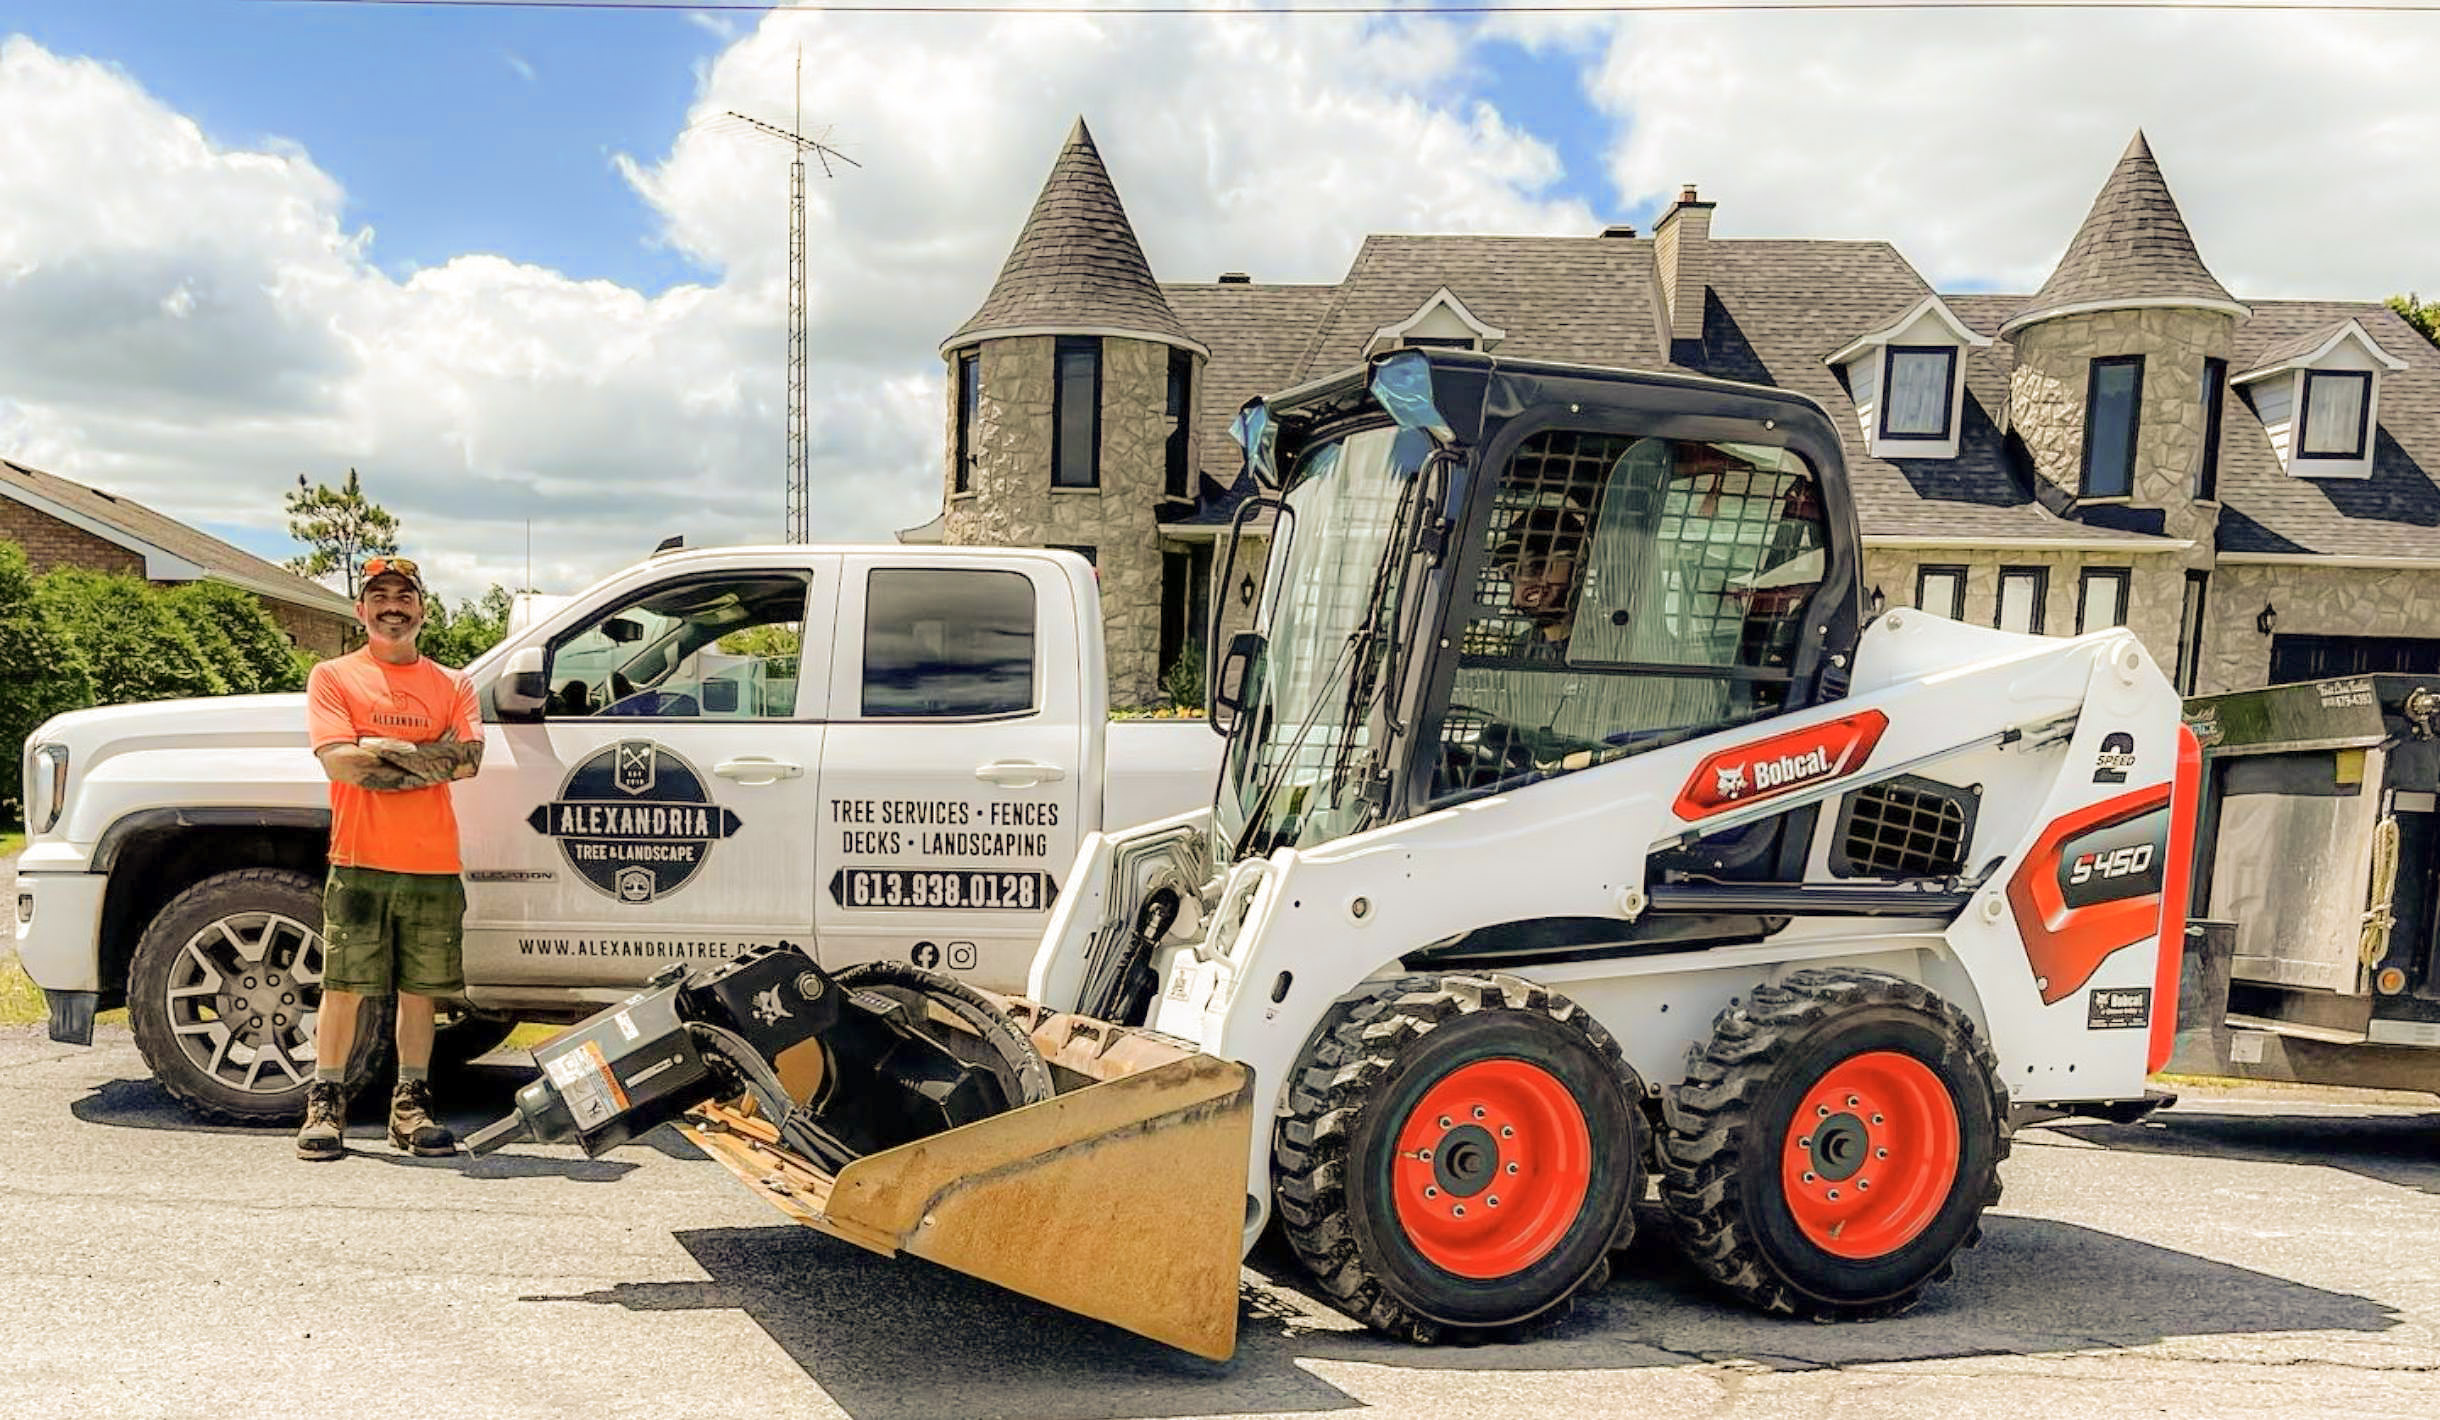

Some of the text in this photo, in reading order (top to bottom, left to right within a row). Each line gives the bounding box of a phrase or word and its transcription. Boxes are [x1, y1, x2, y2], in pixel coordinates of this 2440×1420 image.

[373, 713, 429, 729] ALEXANDRIA
[1752, 744, 1828, 790] Bobcat
[2096, 754, 2136, 767] SPEED
[560, 805, 709, 836] ALEXANDRIA
[831, 799, 1059, 826] TREE SERVICES FENCES
[575, 843, 607, 861] TREE
[617, 844, 695, 862] LANDSCAPE
[843, 830, 1047, 857] DECKS LANDSCAPING
[2069, 843, 2154, 886] S450
[853, 871, 1036, 908] 613.938.0128
[518, 938, 756, 958] WWW.ALEXANDRIATREE.C
